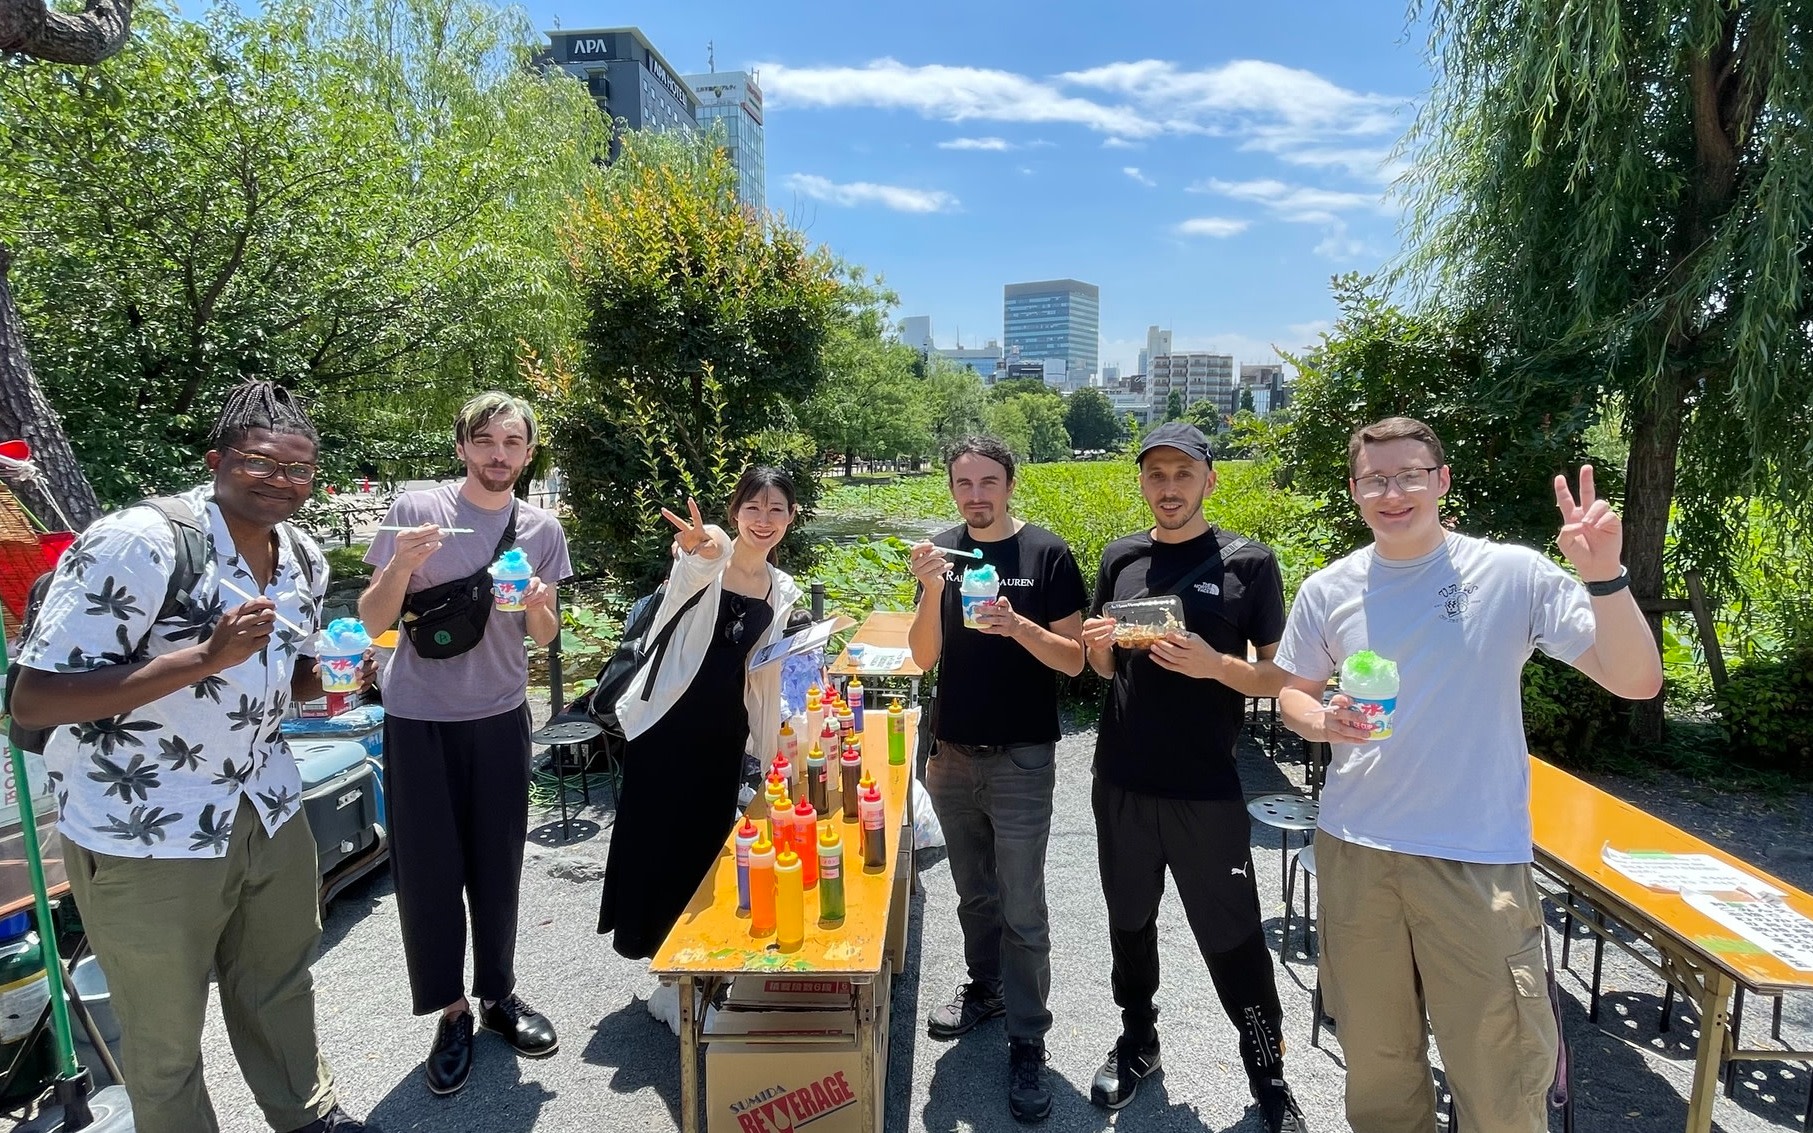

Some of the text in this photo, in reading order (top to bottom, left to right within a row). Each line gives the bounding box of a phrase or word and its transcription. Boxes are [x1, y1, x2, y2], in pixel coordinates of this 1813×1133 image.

[574, 39, 607, 53] APA
[666, 73, 686, 106] HOTEL
[999, 579, 1034, 587] AUREN
[1361, 703, 1384, 717] 氷
[729, 1084, 787, 1114] SUMIDA
[737, 1070, 855, 1133] BEVERAGE
